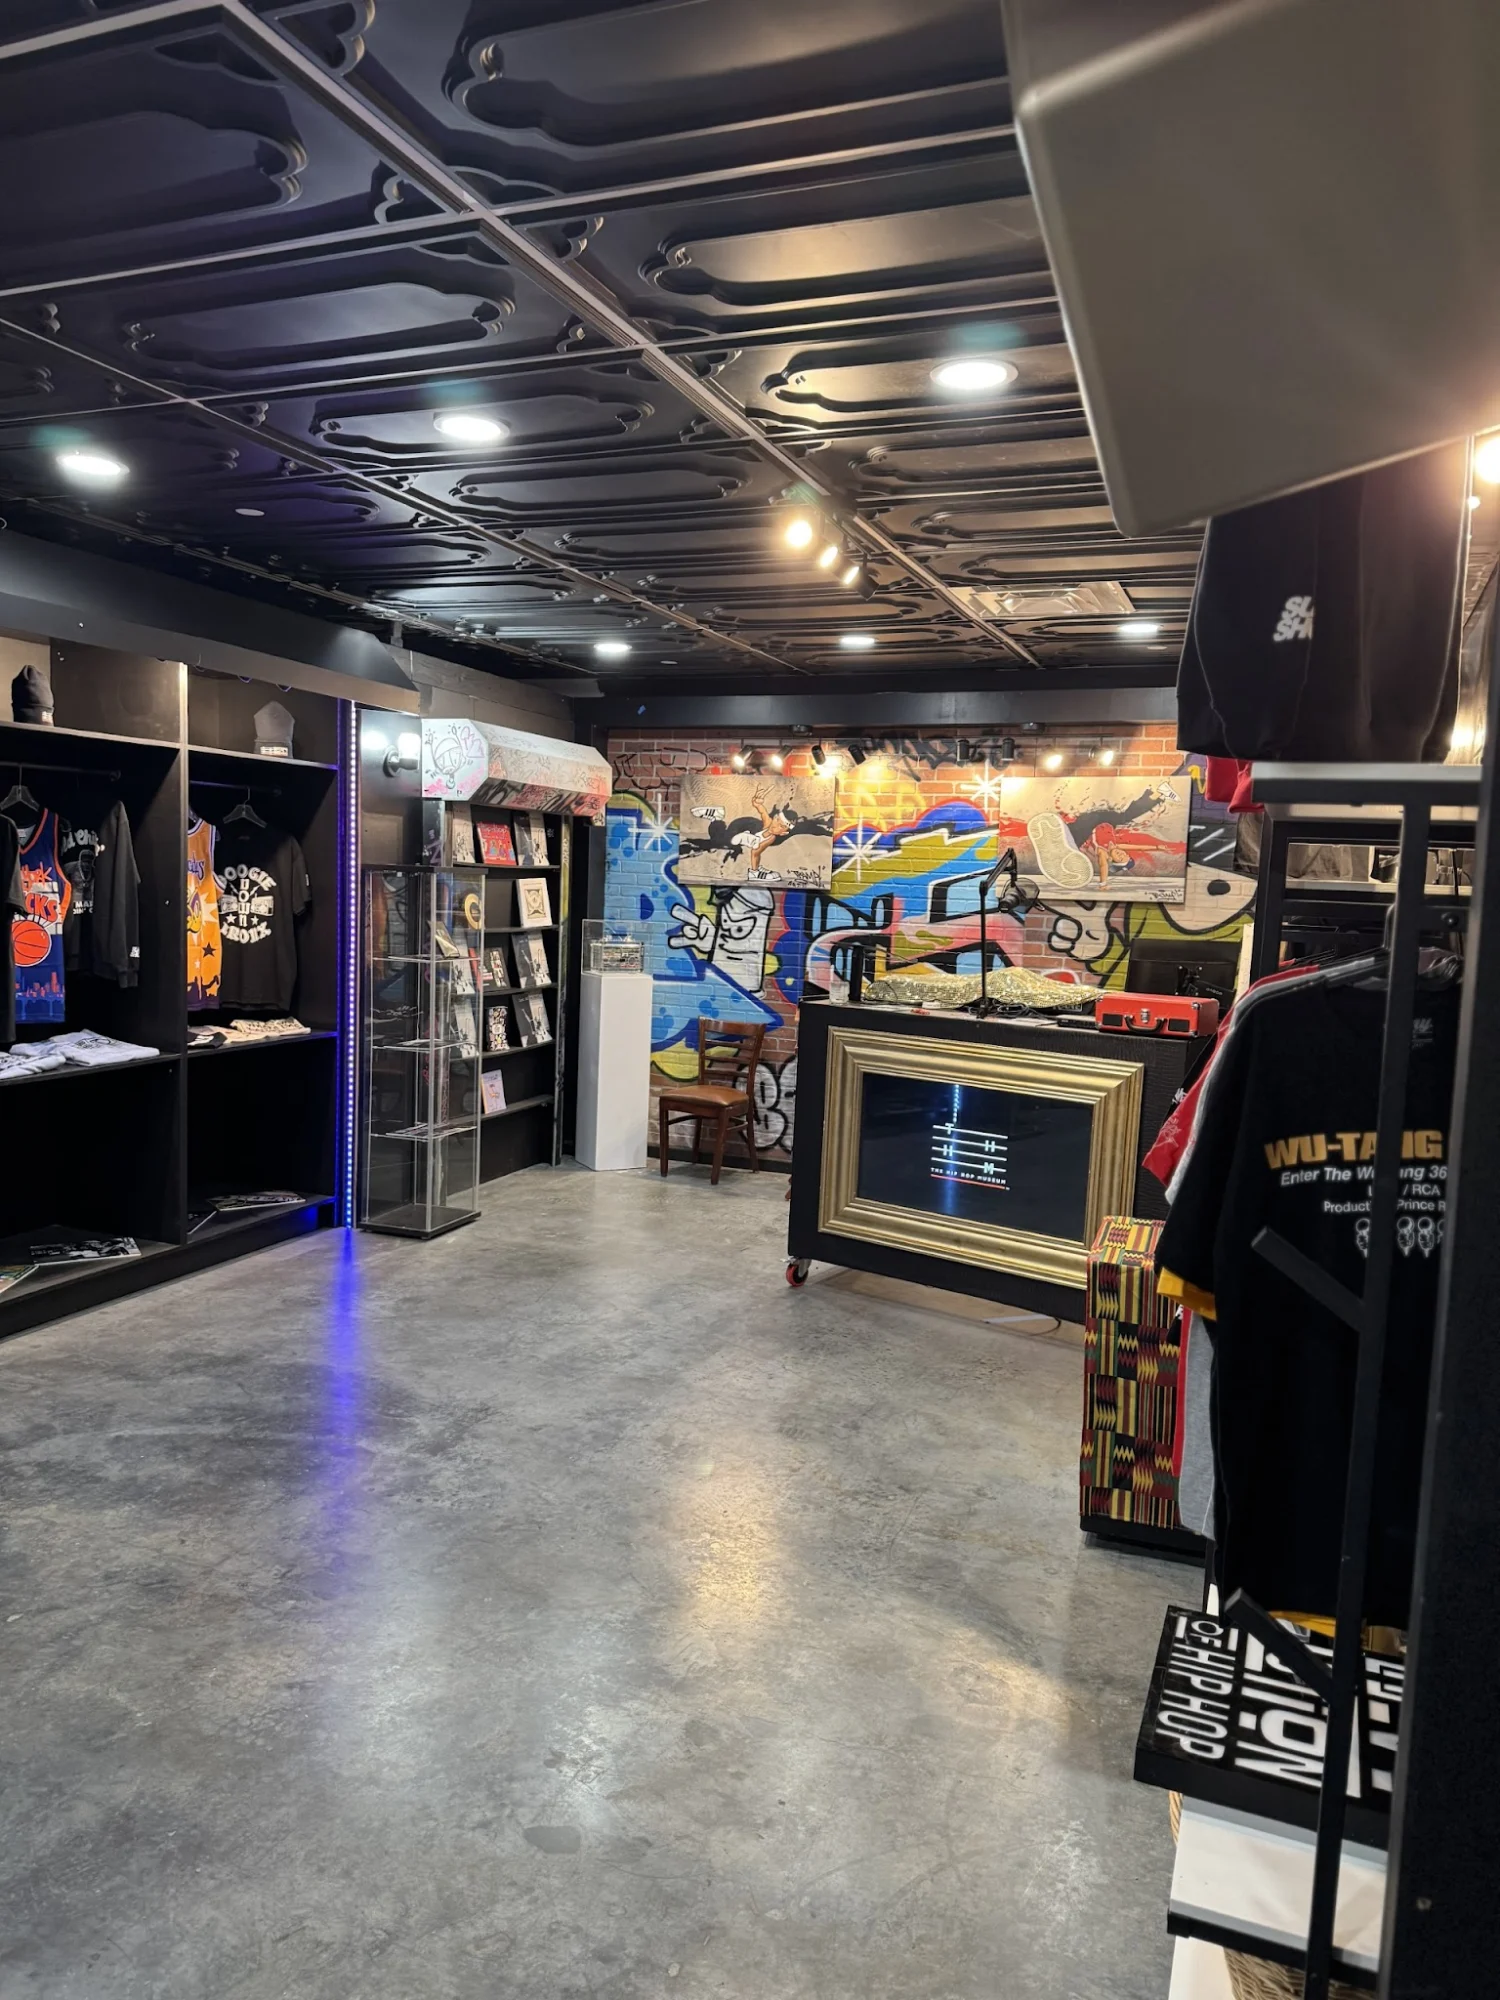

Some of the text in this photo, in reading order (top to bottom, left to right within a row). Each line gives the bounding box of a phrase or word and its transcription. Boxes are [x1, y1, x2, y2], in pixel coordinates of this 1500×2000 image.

[25, 893, 58, 923] CKS
[977, 1175, 1006, 1185] MUSEUM
[1281, 1170, 1320, 1186] Enter
[1324, 1167, 1352, 1181] The
[1412, 1184, 1441, 1195] RCA
[1155, 1620, 1237, 1760] OF HIP HOP
